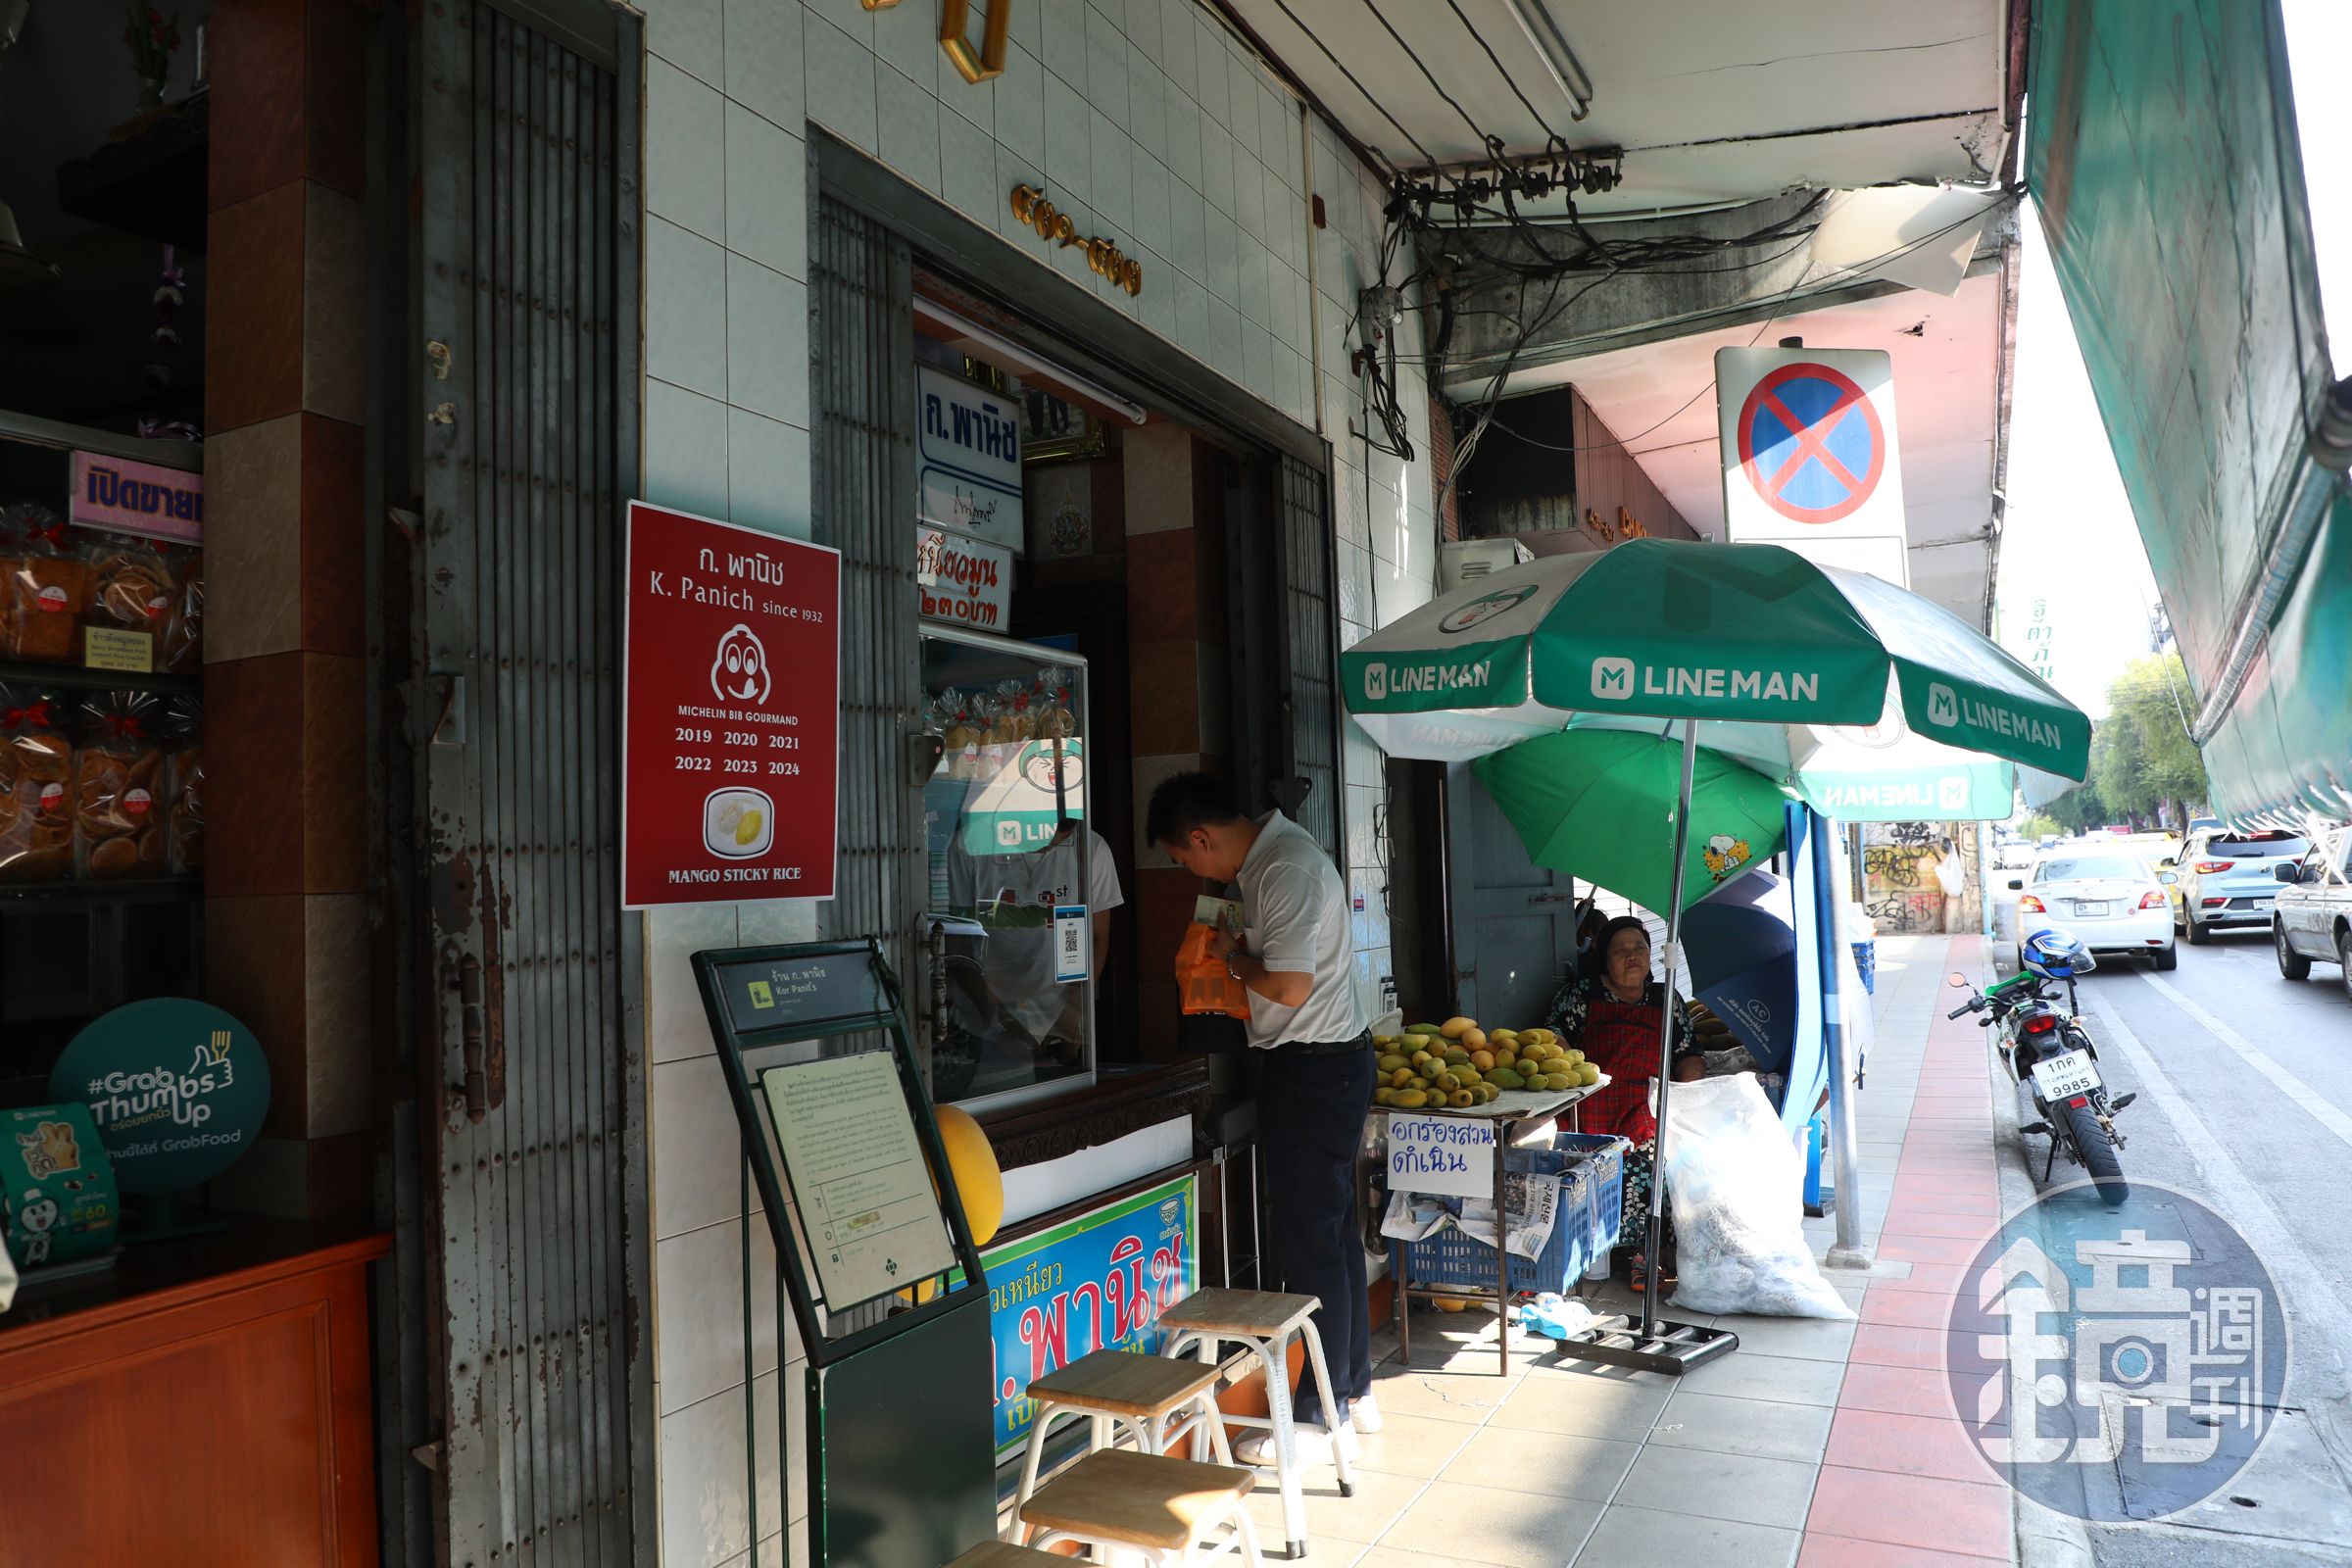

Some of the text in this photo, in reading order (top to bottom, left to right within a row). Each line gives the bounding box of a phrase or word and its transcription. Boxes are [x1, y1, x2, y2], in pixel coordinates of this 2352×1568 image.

[926, 393, 1017, 464] ก. พานิช
[700, 548, 784, 586] ก. พานิช
[651, 571, 823, 623] K. Panich since 1932
[678, 705, 799, 726] MICHELIN BIB GOURMAND
[675, 727, 800, 750] 2019 2020 2021
[675, 756, 801, 776] 2022 2023 2024
[1026, 823, 1057, 840] LIN
[668, 866, 802, 884] MANGO STICKY RICE
[776, 986, 790, 996] Kor
[87, 1066, 174, 1095] #Grab
[2052, 1077, 2090, 1097] 9985
[89, 1072, 216, 1125] Thumbs
[175, 1102, 212, 1128] Up
[162, 1129, 242, 1154] GrabFood
[1392, 1116, 1494, 1145] อกร่องสวน
[1393, 1145, 1468, 1174] ดำเนิน
[1539, 1181, 1555, 1225] 국제신문
[990, 1260, 1063, 1313] วเหนียว
[1019, 1233, 1183, 1386] พานิช
